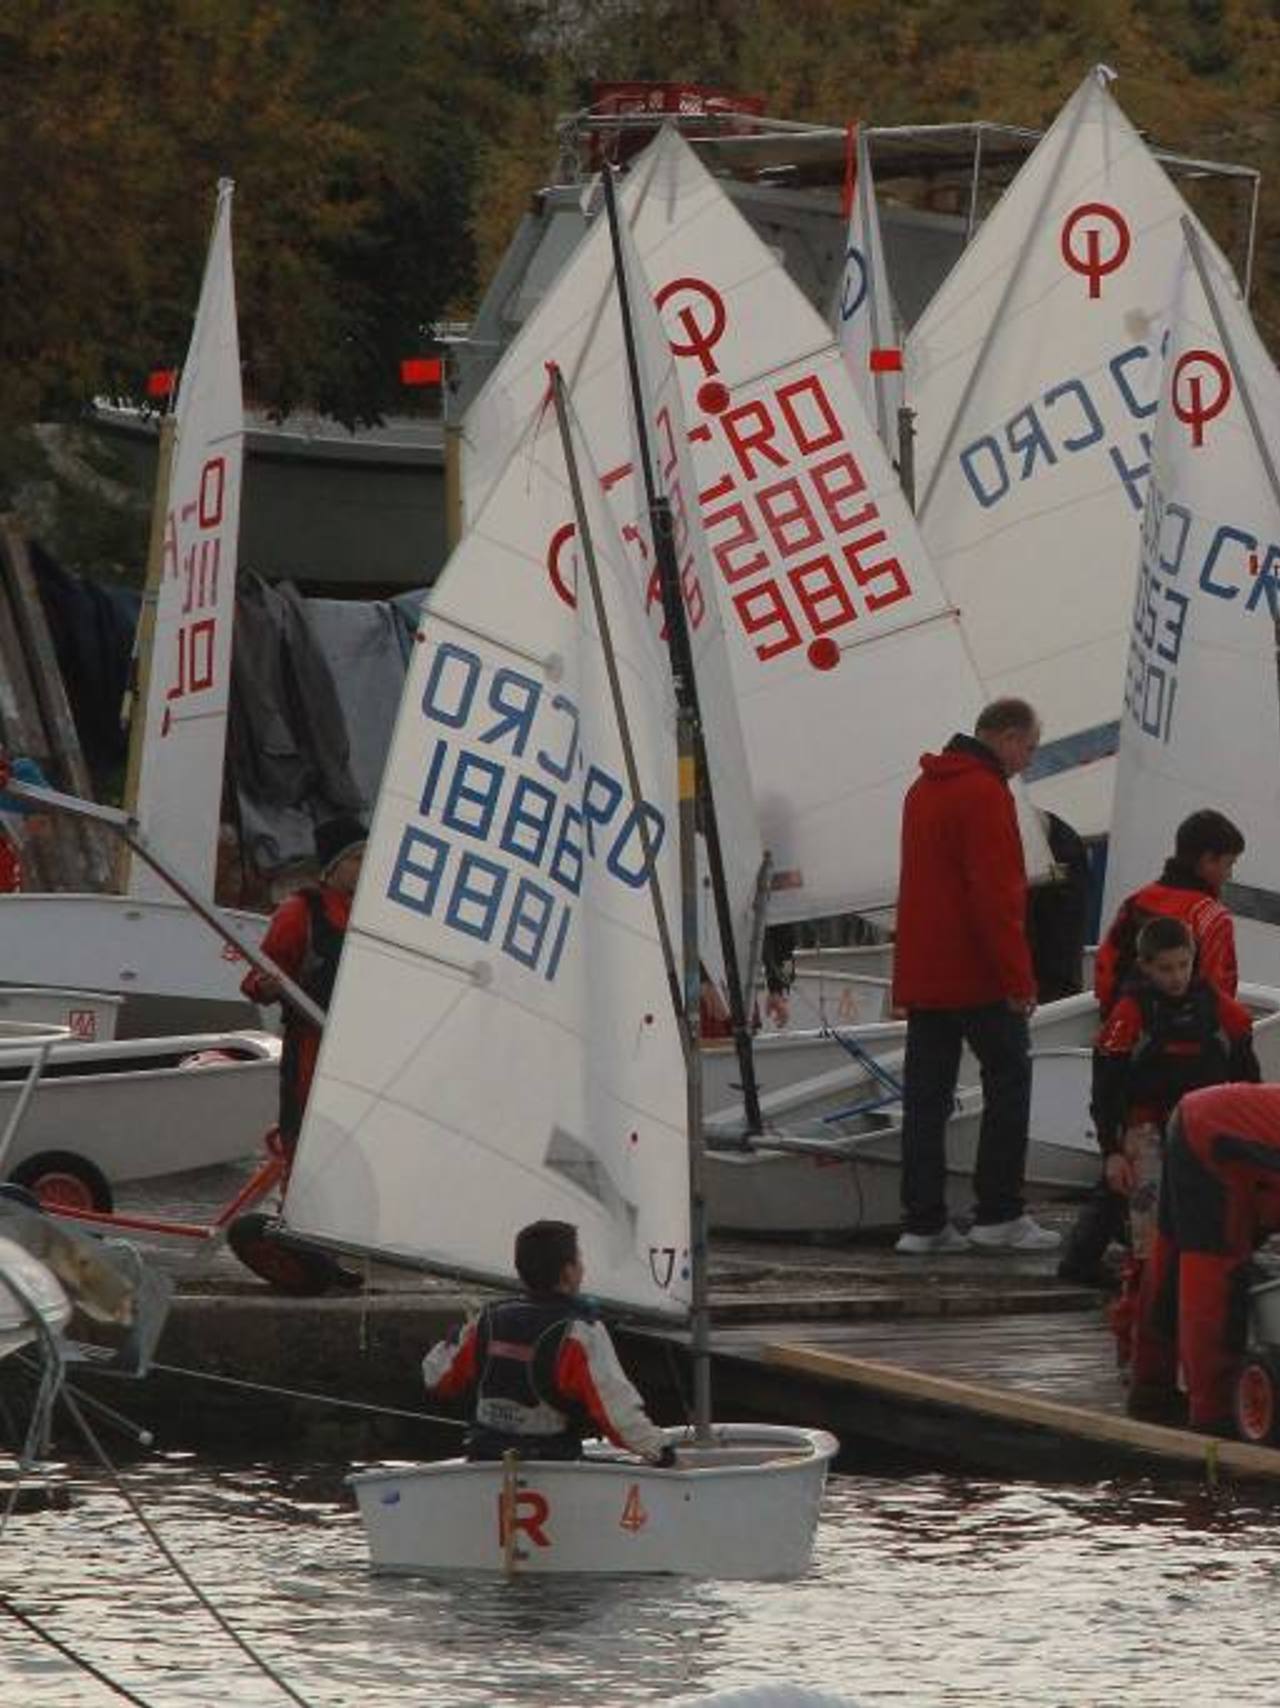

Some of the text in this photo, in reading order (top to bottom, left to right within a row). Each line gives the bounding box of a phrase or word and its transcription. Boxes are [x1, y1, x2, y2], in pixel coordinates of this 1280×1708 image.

[732, 530, 912, 662] 985
[582, 764, 666, 888] RO
[497, 1488, 551, 1547] R
